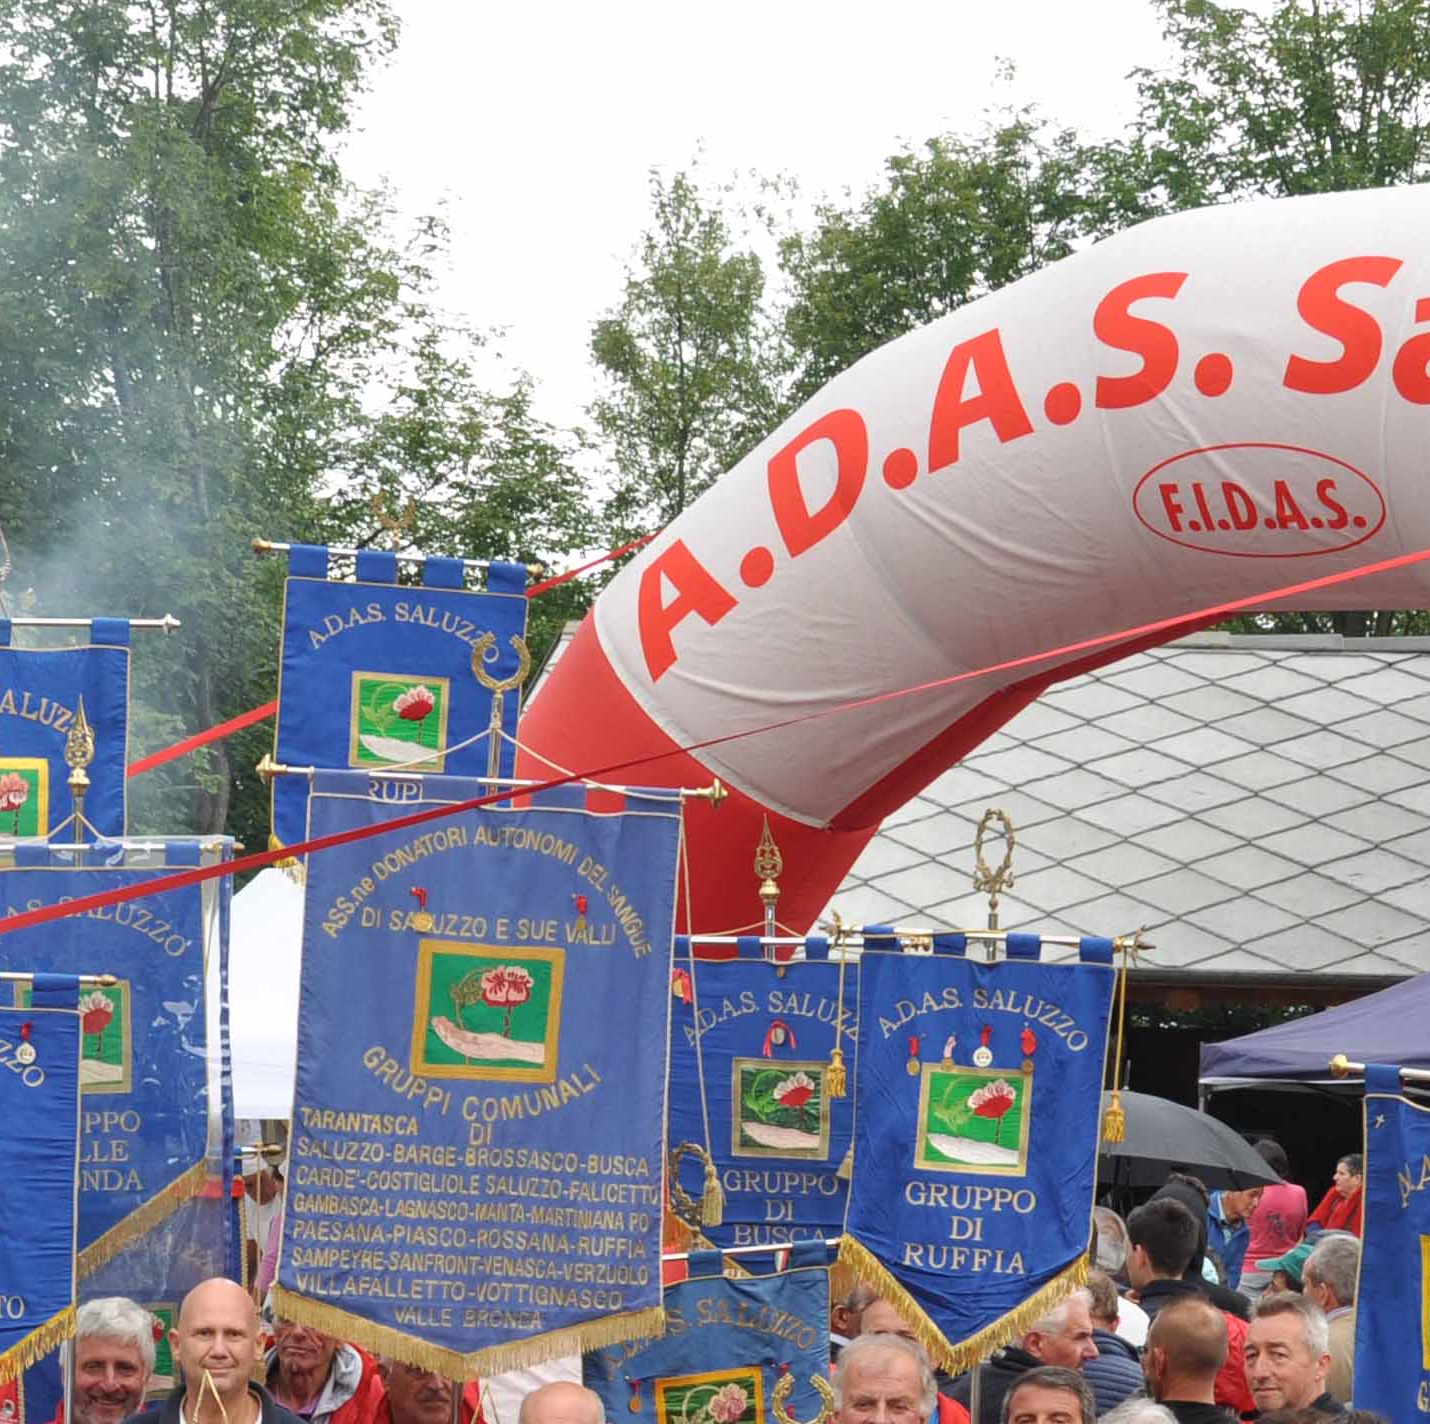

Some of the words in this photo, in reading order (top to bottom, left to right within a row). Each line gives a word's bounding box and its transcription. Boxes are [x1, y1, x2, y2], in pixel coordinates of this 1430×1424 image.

[636, 270, 1233, 682] A.D.A.S.
[1159, 479, 1366, 532] F.I.D.A.S.
[372, 826, 468, 882] DONATORI
[474, 826, 579, 866] AUTONOMI
[578, 857, 604, 893] DEL
[607, 885, 652, 960] SANGUE
[361, 907, 381, 929] DI
[496, 918, 509, 940] E
[516, 918, 556, 942] SUE
[566, 922, 616, 945] VALLI
[973, 986, 1089, 1053] SALUZZO
[363, 1046, 451, 1115] GRUPPI
[462, 1063, 602, 1121] COMUNALI
[301, 1107, 419, 1135] TARANTASCA
[469, 1122, 492, 1146] DI
[721, 1169, 839, 1197] GRUPPO
[765, 1200, 794, 1222] DI
[905, 1182, 1037, 1214] GRUPPO
[628, 1211, 650, 1233] PO
[733, 1225, 827, 1247] BUSCA
[950, 1216, 983, 1242] DI
[903, 1244, 1027, 1275] RUFFIA
[395, 1307, 452, 1329] VALLE
